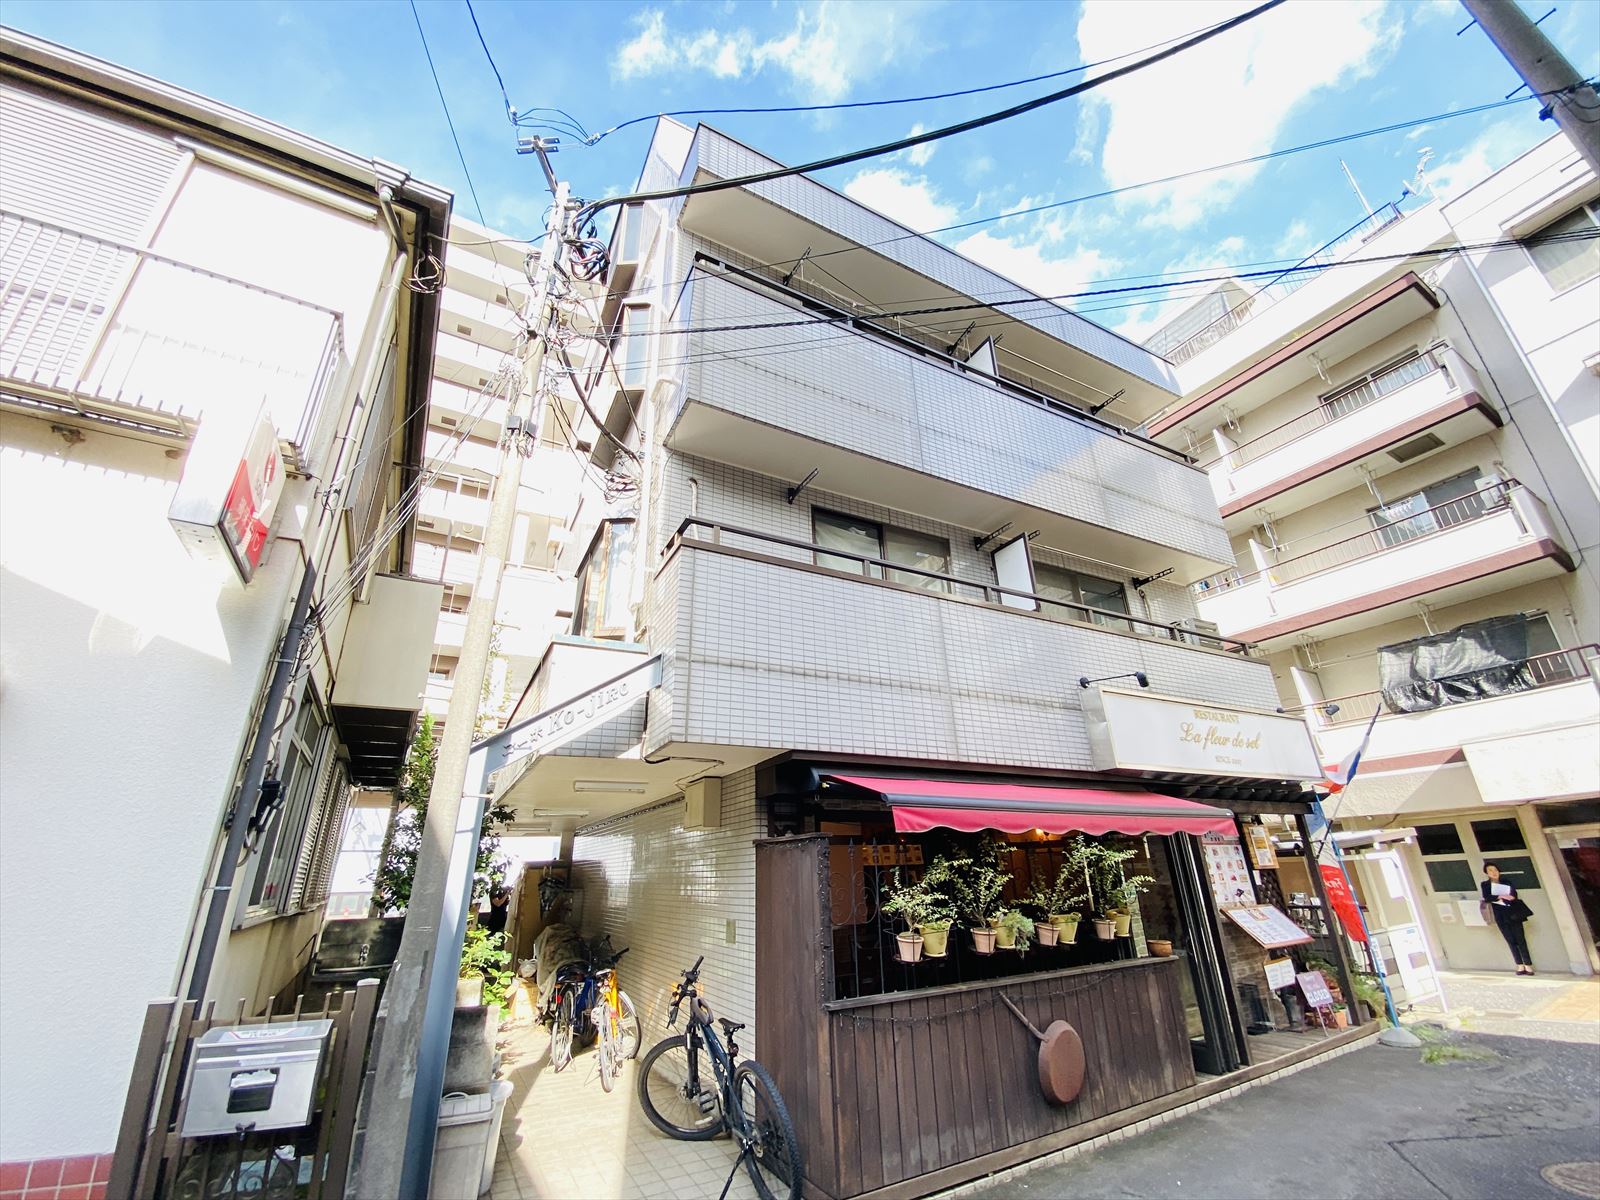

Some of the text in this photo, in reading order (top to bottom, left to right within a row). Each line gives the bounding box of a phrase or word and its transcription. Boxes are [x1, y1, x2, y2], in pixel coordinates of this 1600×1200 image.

[1195, 710, 1240, 723] RESTAURANT
[1180, 722, 1262, 750] La fleur de sel
